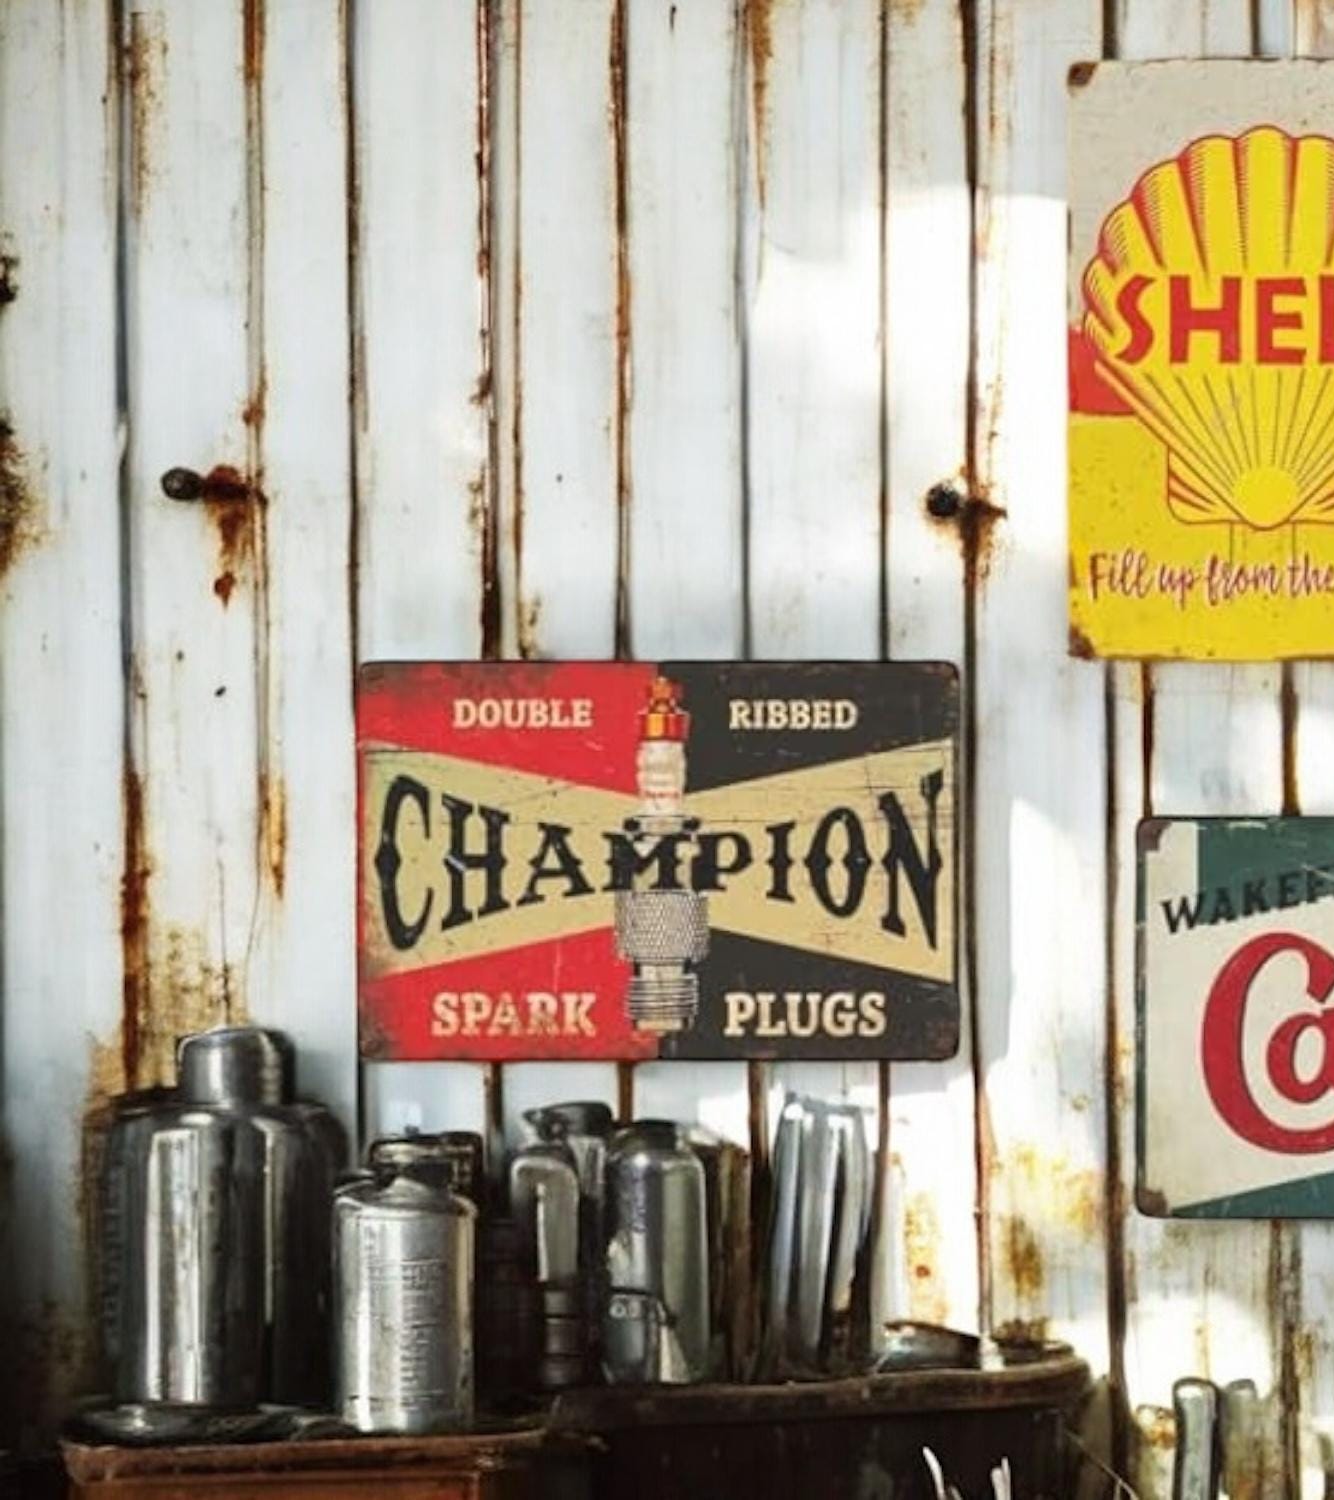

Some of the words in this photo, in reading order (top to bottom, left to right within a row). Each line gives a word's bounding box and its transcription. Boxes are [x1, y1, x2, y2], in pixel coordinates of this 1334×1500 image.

[1088, 549, 1148, 601] Fill
[1157, 562, 1198, 611] up
[1203, 554, 1280, 607] from
[452, 699, 594, 730] DOUBLE
[729, 699, 858, 731] RIBBED
[374, 768, 947, 952] CHAMPION
[432, 991, 598, 1038] SPARK
[723, 992, 886, 1038] PLUGS
